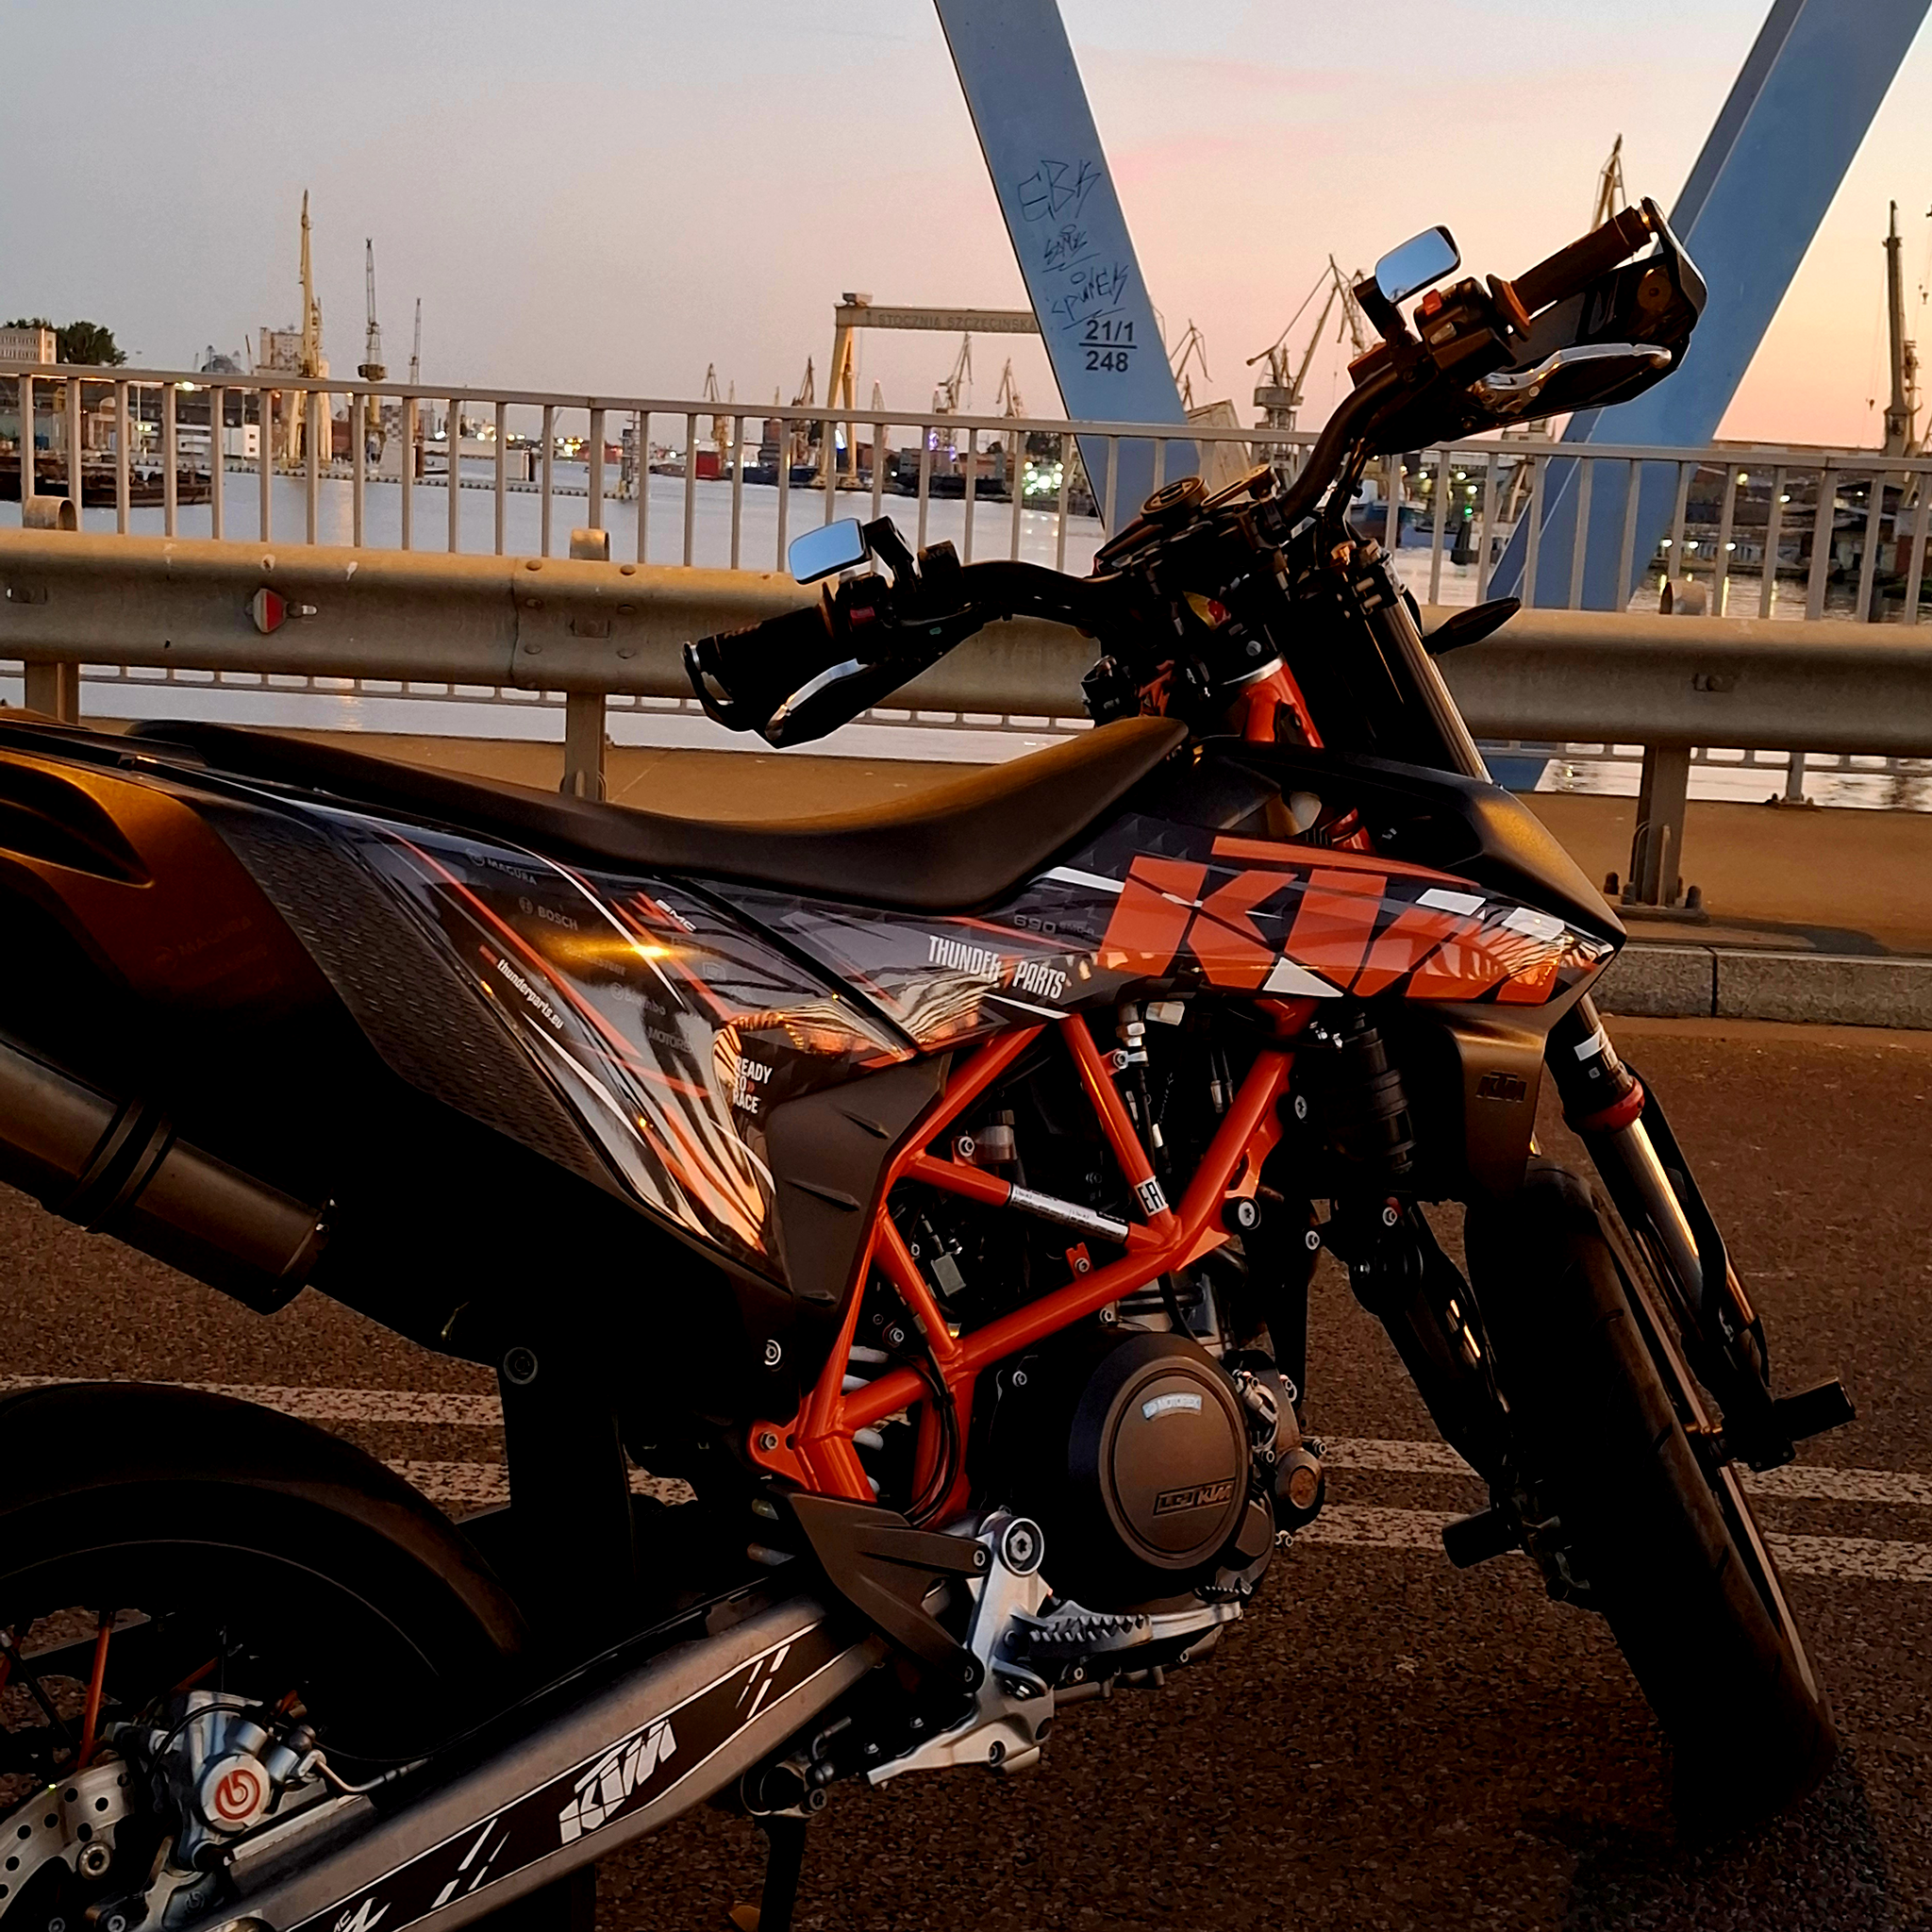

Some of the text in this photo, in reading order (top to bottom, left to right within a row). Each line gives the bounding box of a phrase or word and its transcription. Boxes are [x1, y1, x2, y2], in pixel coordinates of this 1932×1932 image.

[878, 314, 940, 329] STOCZNIA
[1085, 320, 1134, 342] 21/1
[1085, 351, 1129, 373] 248
[486, 857, 539, 886] MAGURA
[537, 905, 579, 931] BOSCH
[1013, 913, 1057, 935] 690
[928, 935, 1067, 1000] THUNDER PARTS
[497, 958, 565, 1030] thunderparts.eu
[735, 1055, 774, 1085] READY
[1475, 1070, 1527, 1103] KTM
[733, 1089, 762, 1114] RACE
[1196, 1482, 1234, 1507] KTM
[558, 1719, 677, 1845] KTM
